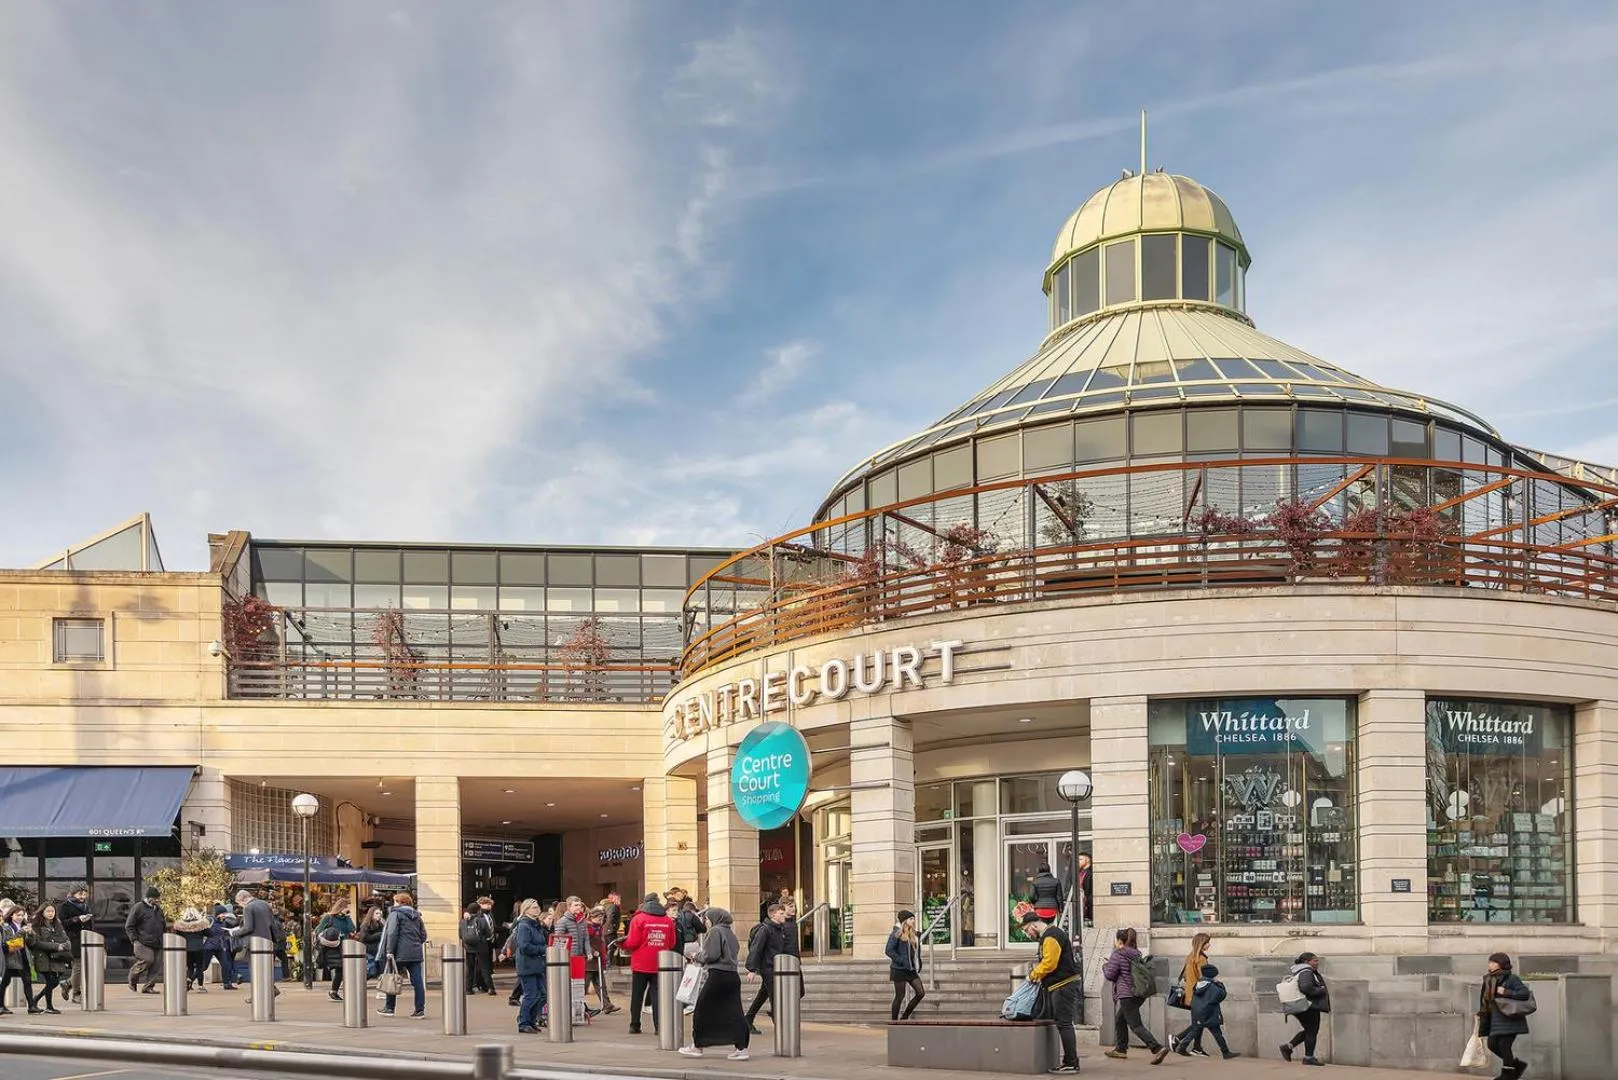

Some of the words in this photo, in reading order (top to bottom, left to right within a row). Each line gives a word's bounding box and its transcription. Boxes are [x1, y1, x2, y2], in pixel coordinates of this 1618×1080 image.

[1200, 709, 1311, 732] Whittard
[1446, 710, 1534, 734] Whittard
[1215, 733, 1267, 743] CHELSEA
[1272, 732, 1297, 741] 1886
[1457, 734, 1500, 744] CHELSEA
[1503, 735, 1523, 745] 1886
[741, 753, 793, 774] Centre
[739, 772, 781, 793] Court
[742, 791, 780, 806] Shopping
[243, 856, 265, 864] The
[599, 846, 640, 862] KOKORO
